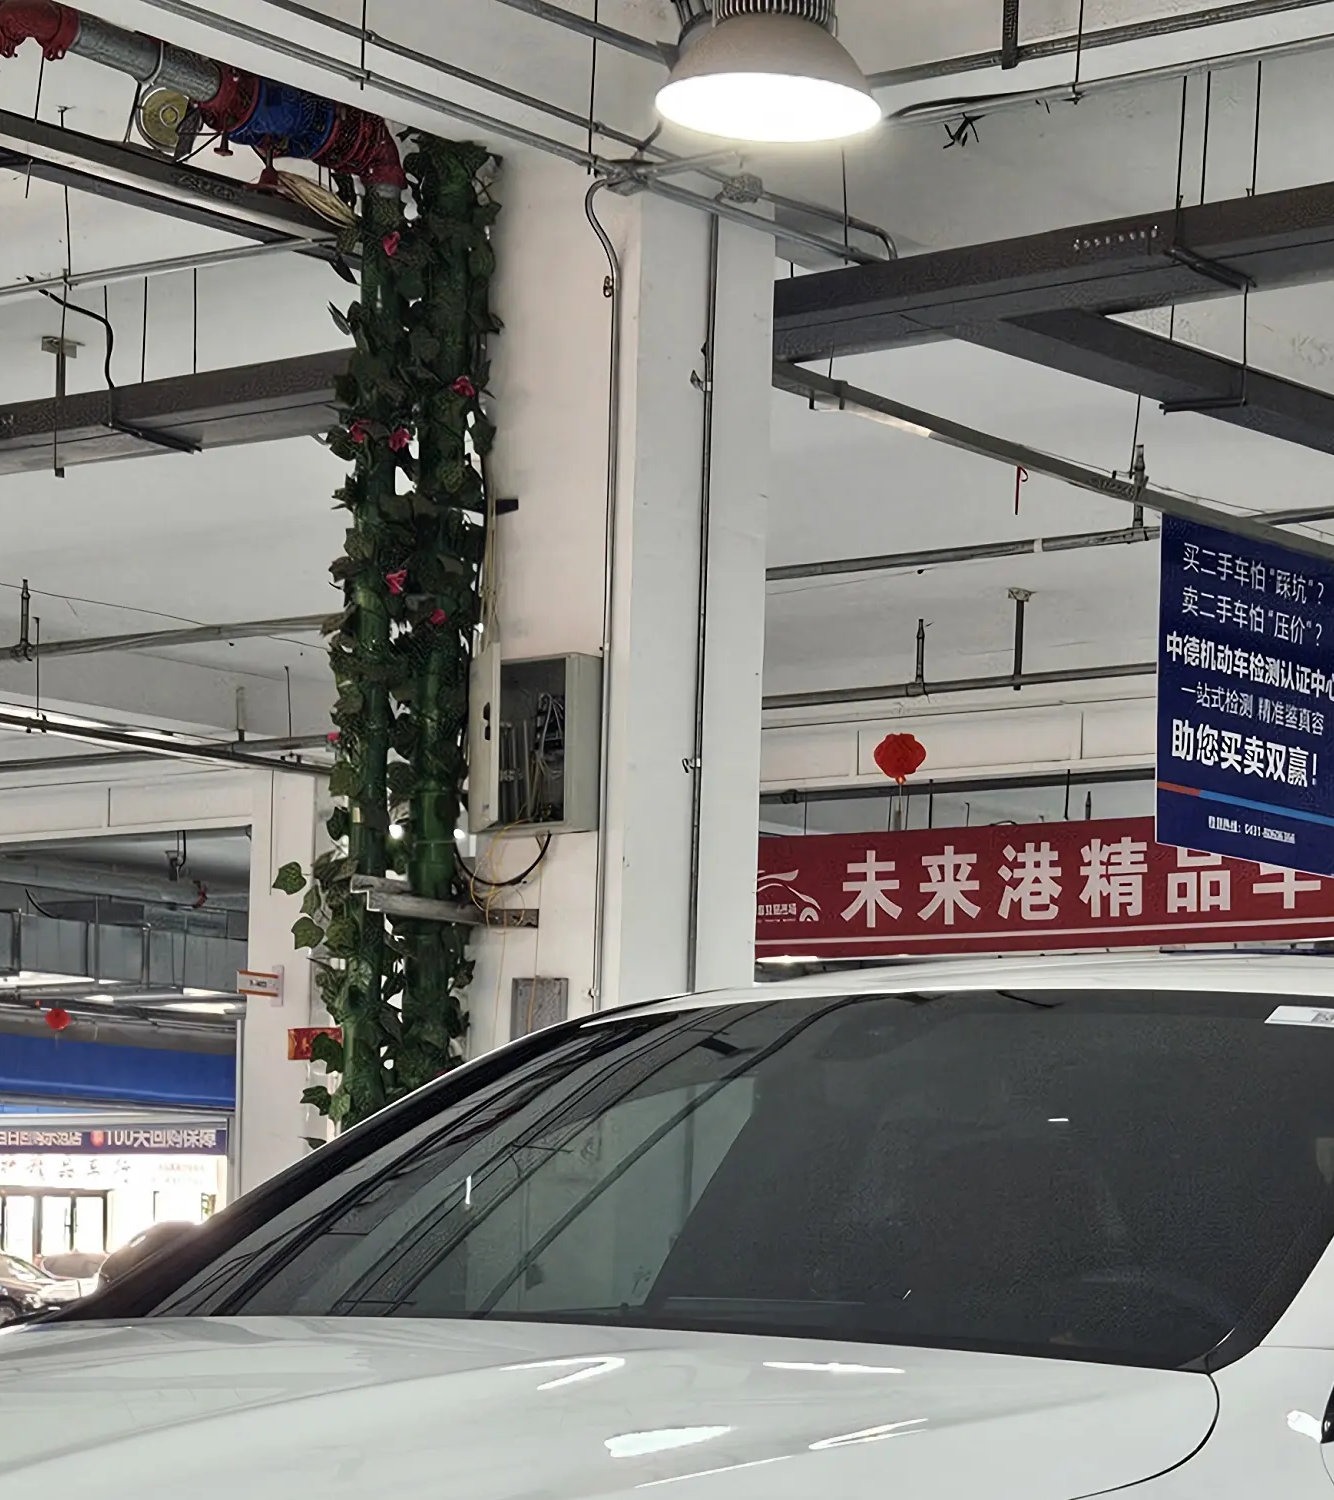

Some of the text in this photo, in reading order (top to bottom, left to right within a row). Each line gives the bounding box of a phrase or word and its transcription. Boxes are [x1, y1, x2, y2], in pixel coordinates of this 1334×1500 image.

[1181, 681, 1254, 719] 一站式检测
[1171, 718, 1318, 788] 助您买卖双赢！
